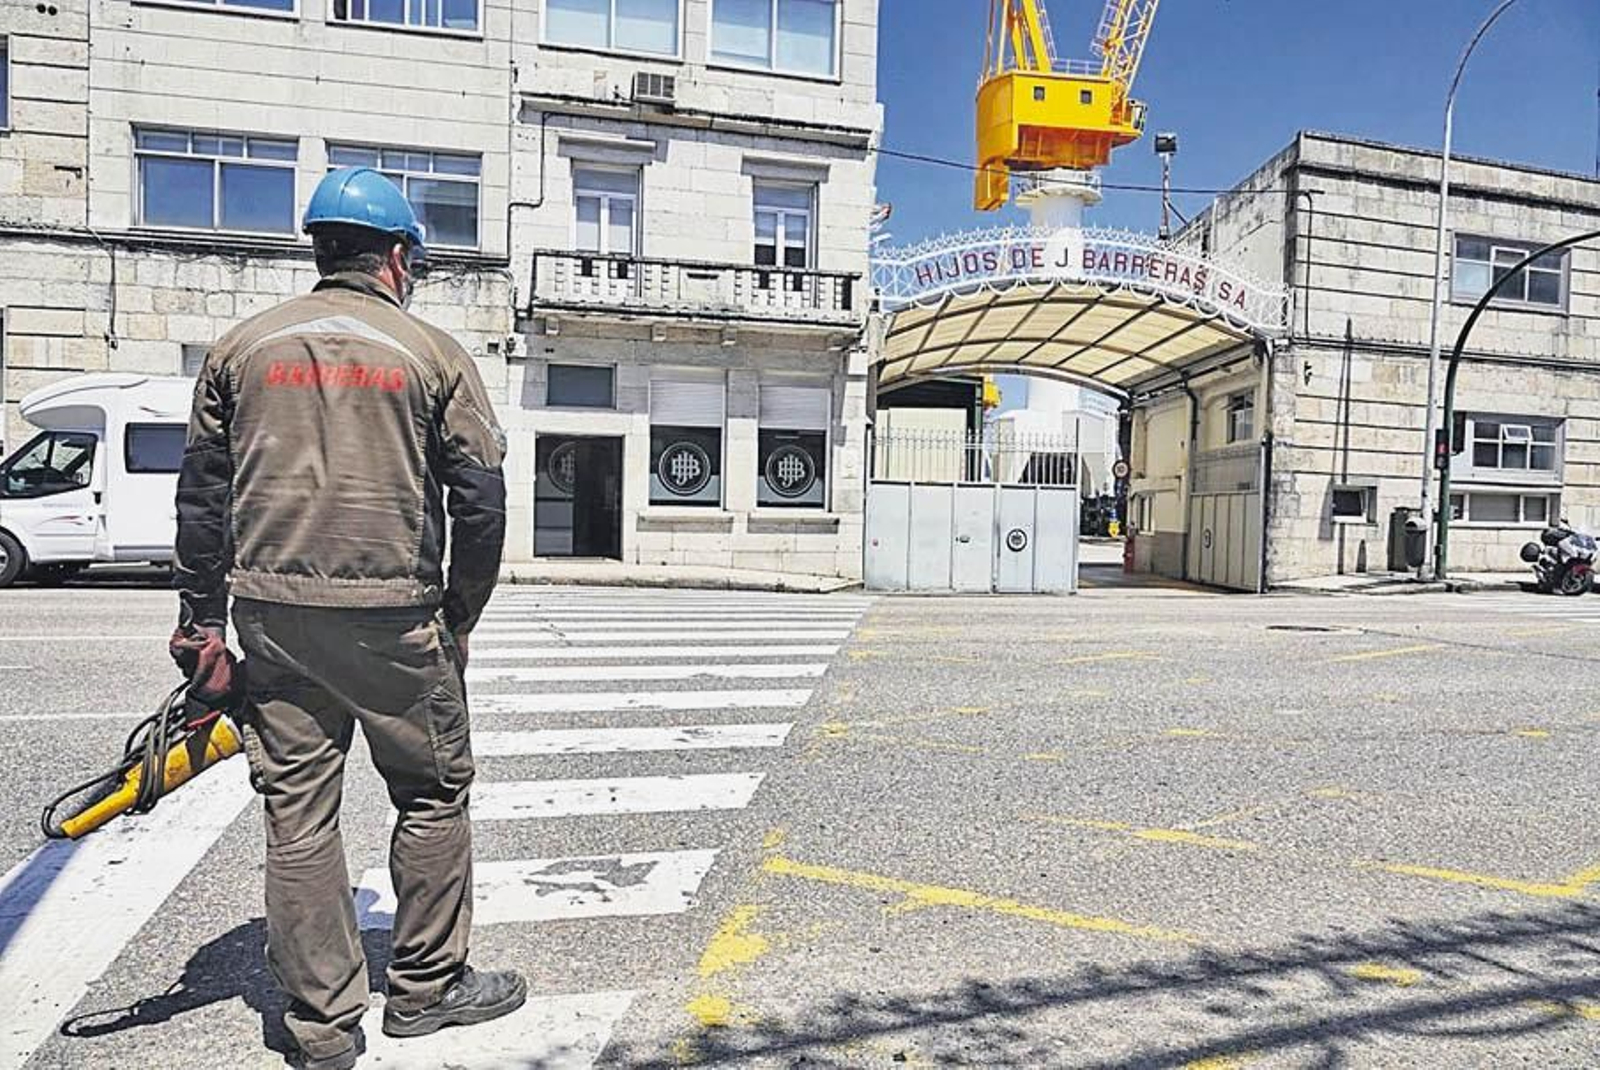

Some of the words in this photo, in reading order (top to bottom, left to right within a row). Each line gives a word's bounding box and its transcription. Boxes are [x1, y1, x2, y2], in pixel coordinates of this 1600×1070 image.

[915, 252, 998, 286] HIJOS
[1012, 248, 1045, 269] DE
[1082, 249, 1207, 291] BARRERAS
